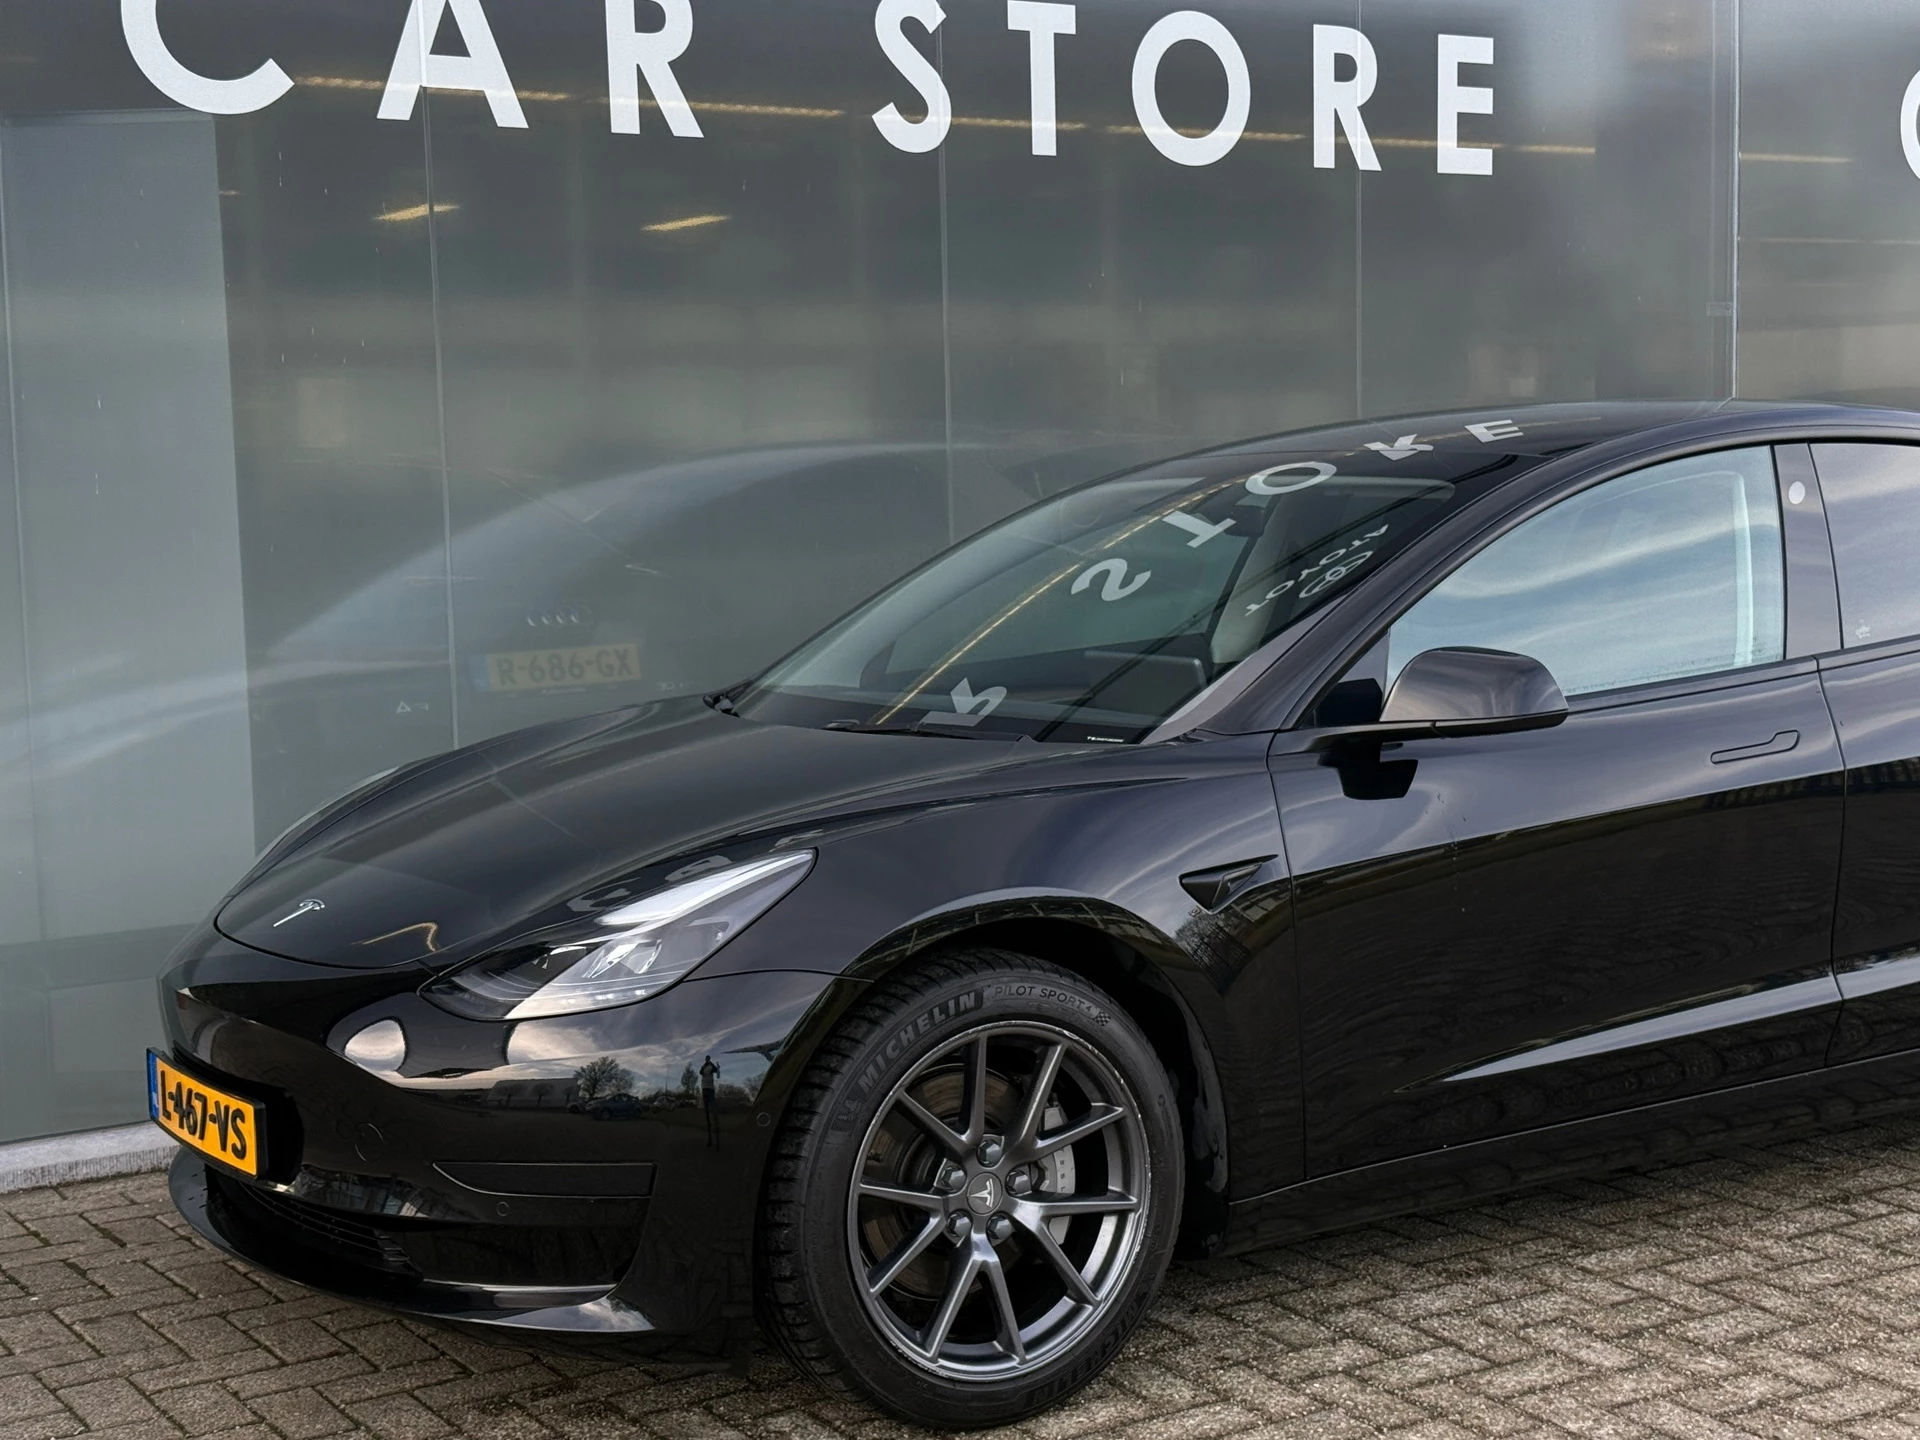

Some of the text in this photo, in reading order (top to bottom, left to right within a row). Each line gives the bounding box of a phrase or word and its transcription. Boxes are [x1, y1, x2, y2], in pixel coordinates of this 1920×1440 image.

[121, 0, 1494, 176] CAR STORE
[496, 648, 634, 687] R-686-GX
[858, 990, 976, 1094] MICHELIN
[994, 985, 1036, 998] PILOT
[1039, 988, 1086, 1010] SPORT
[160, 1070, 247, 1160] L-467-VS
